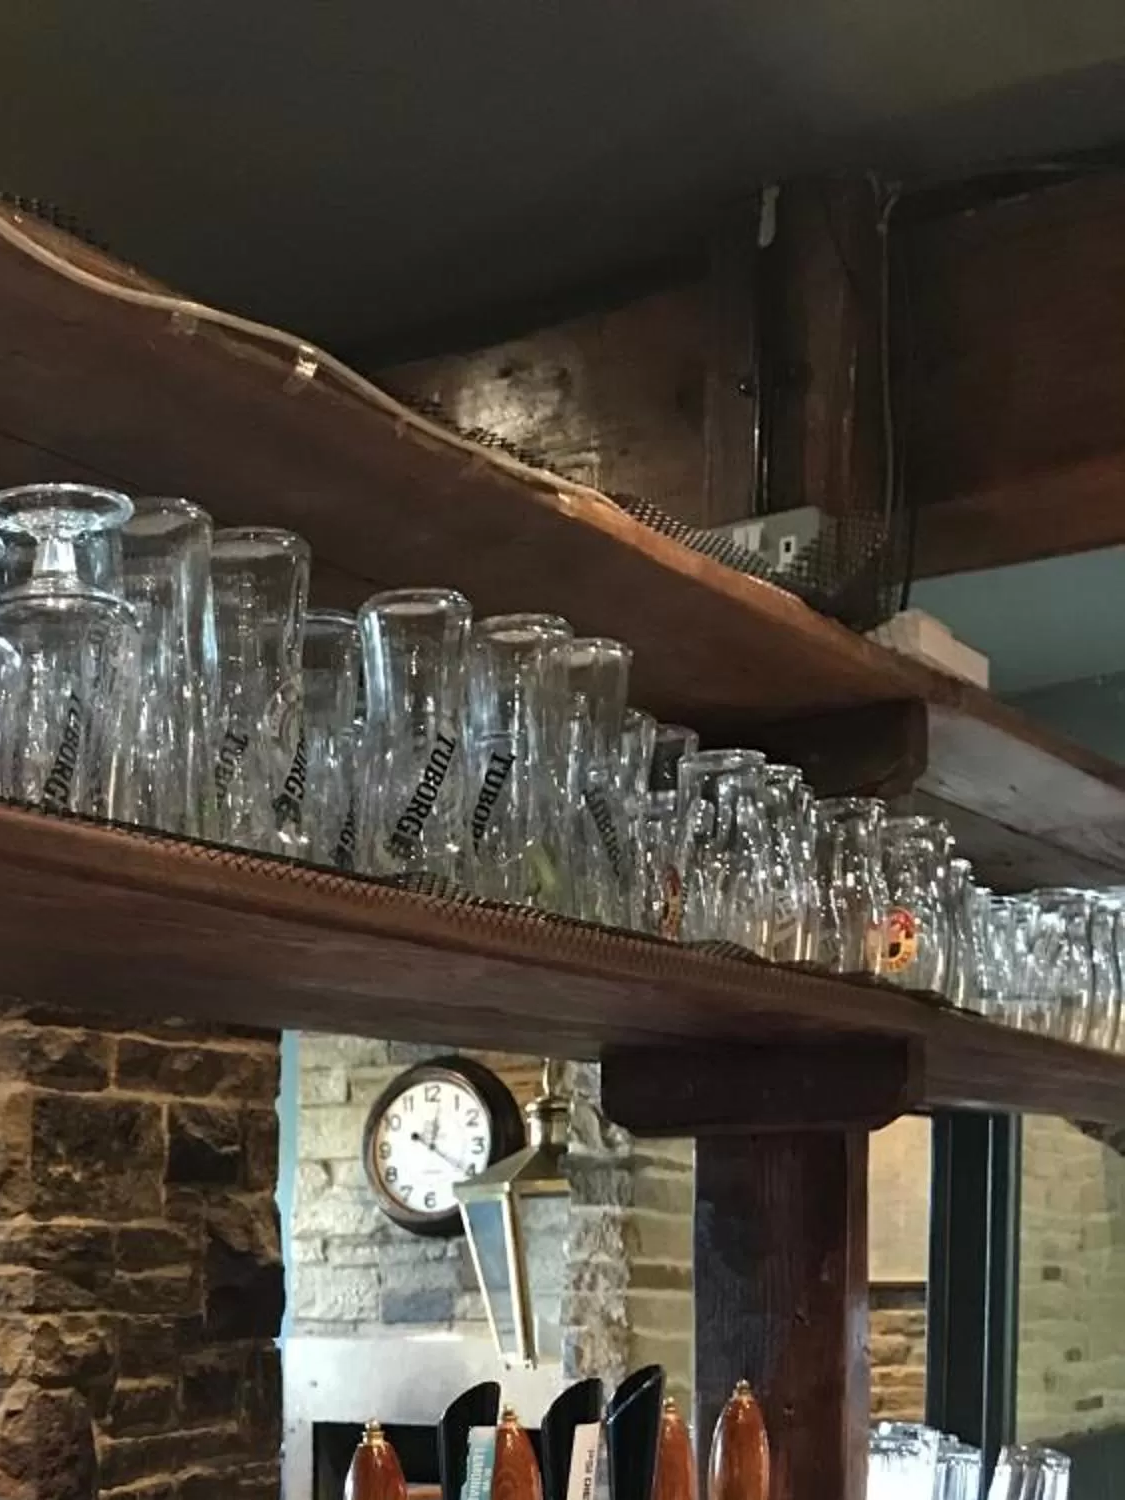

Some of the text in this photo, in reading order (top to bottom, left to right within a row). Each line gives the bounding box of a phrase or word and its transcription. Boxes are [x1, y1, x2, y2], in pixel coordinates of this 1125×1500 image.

[393, 732, 456, 838] TUBORG
[424, 1084, 441, 1103] 12
[455, 1093, 460, 1112] 1
[466, 1108, 479, 1127] 2
[378, 1141, 392, 1160] 9
[471, 1136, 484, 1155] 3
[385, 1166, 398, 1184] 8
[424, 1191, 437, 1209] 6
